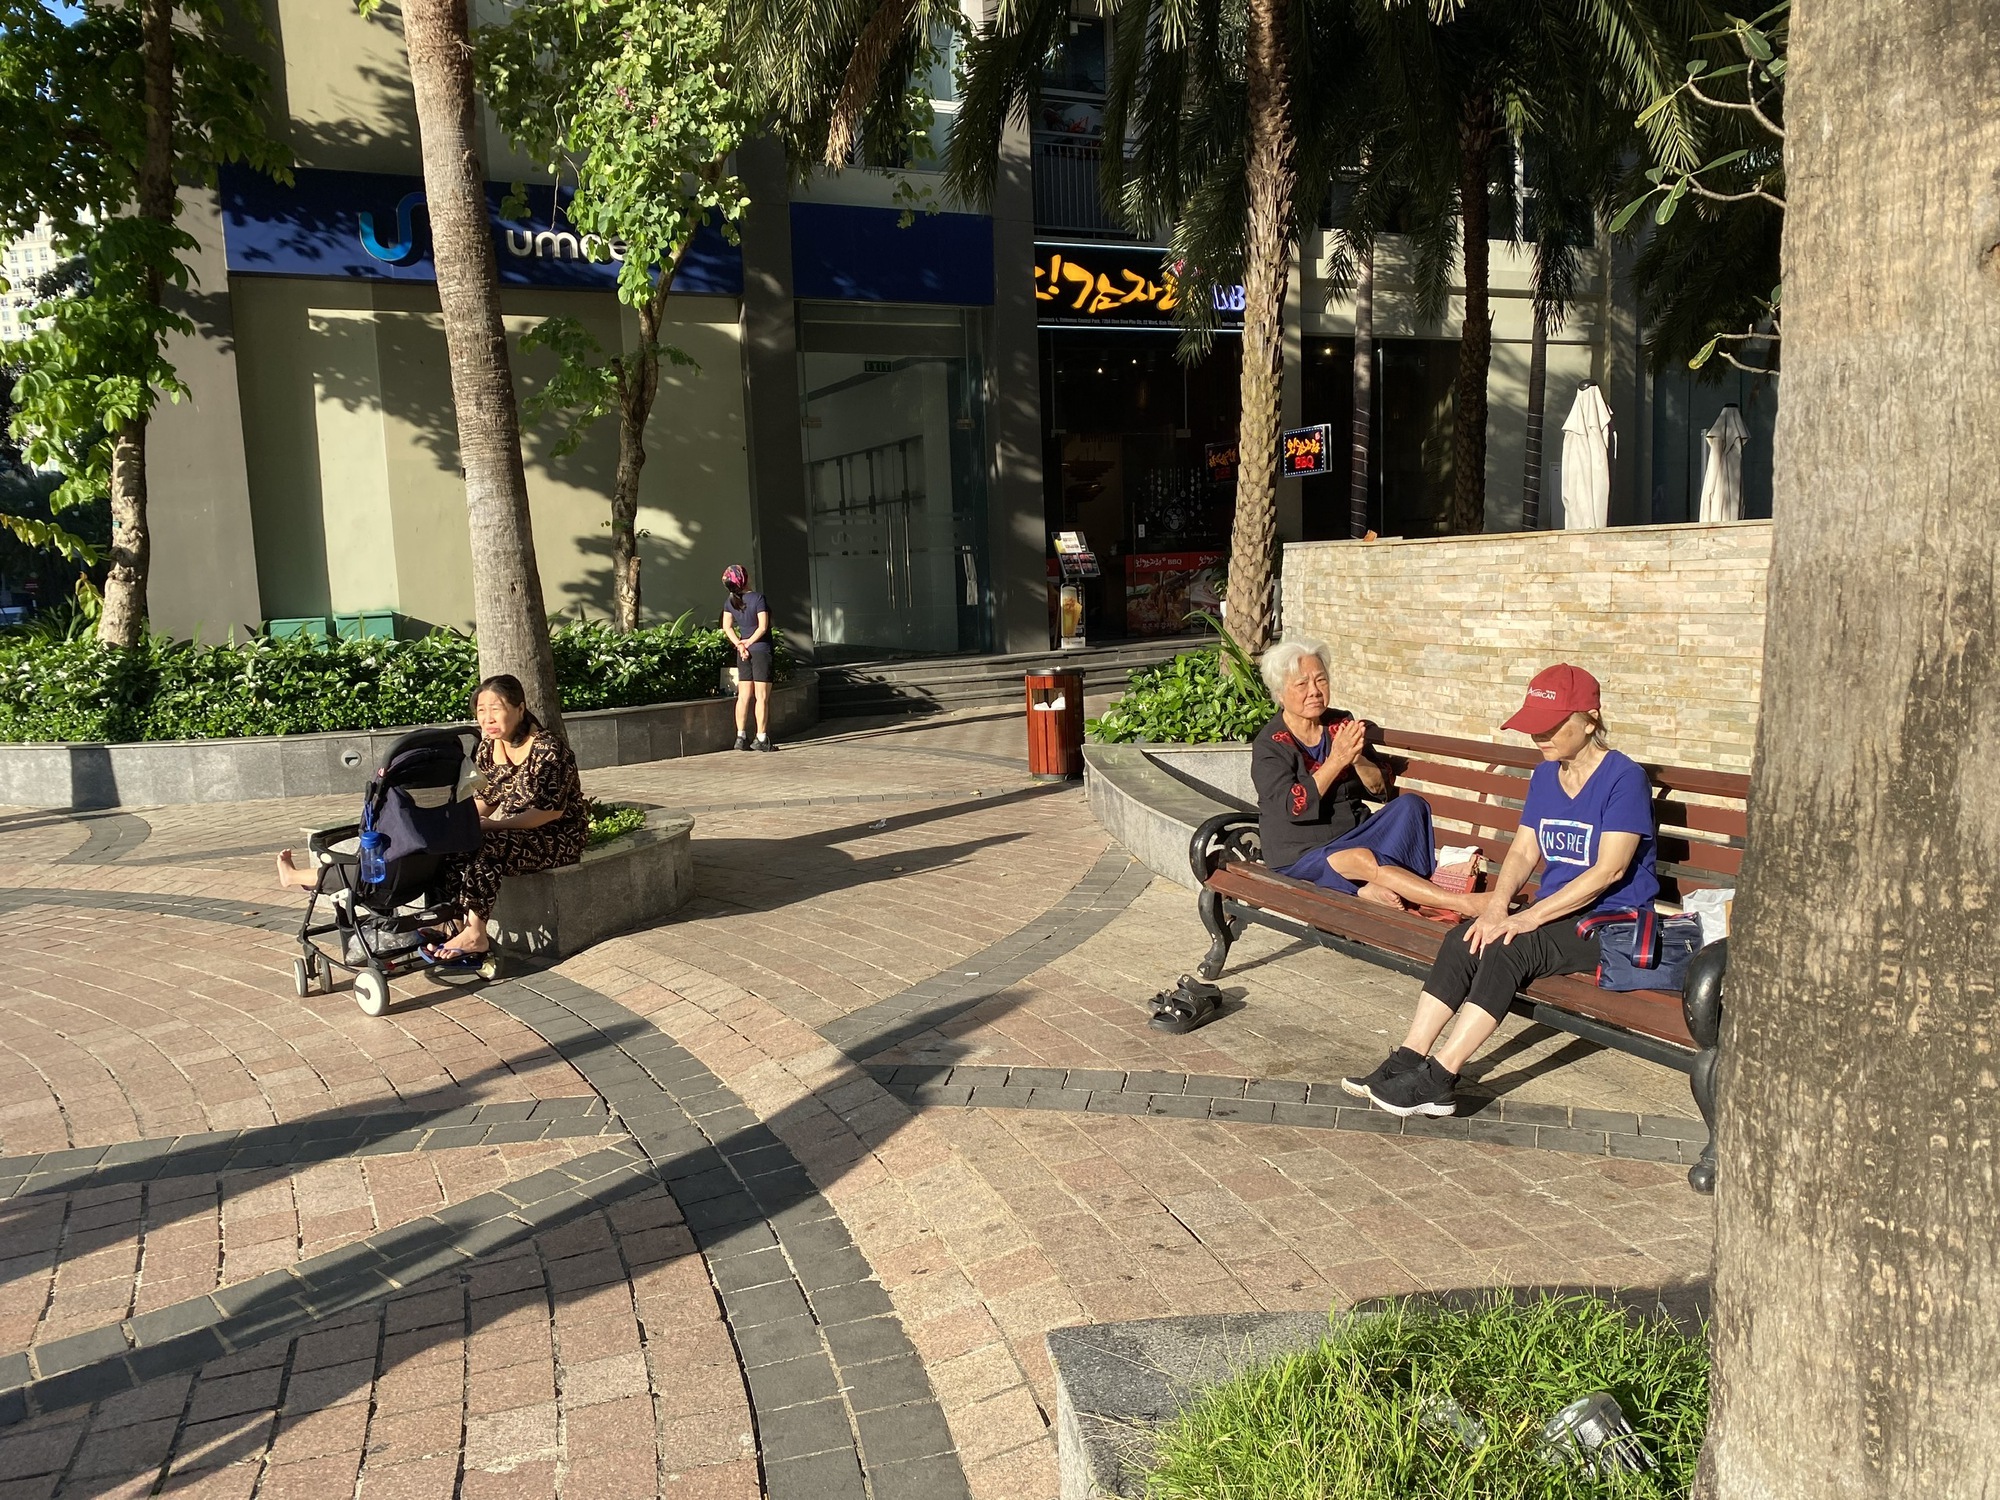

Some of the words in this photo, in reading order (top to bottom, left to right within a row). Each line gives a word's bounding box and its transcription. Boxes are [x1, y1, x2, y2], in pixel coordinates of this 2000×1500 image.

[866, 362, 890, 372] EXIT
[1295, 455, 1314, 468] BBQ
[1167, 558, 1182, 566] BBQ
